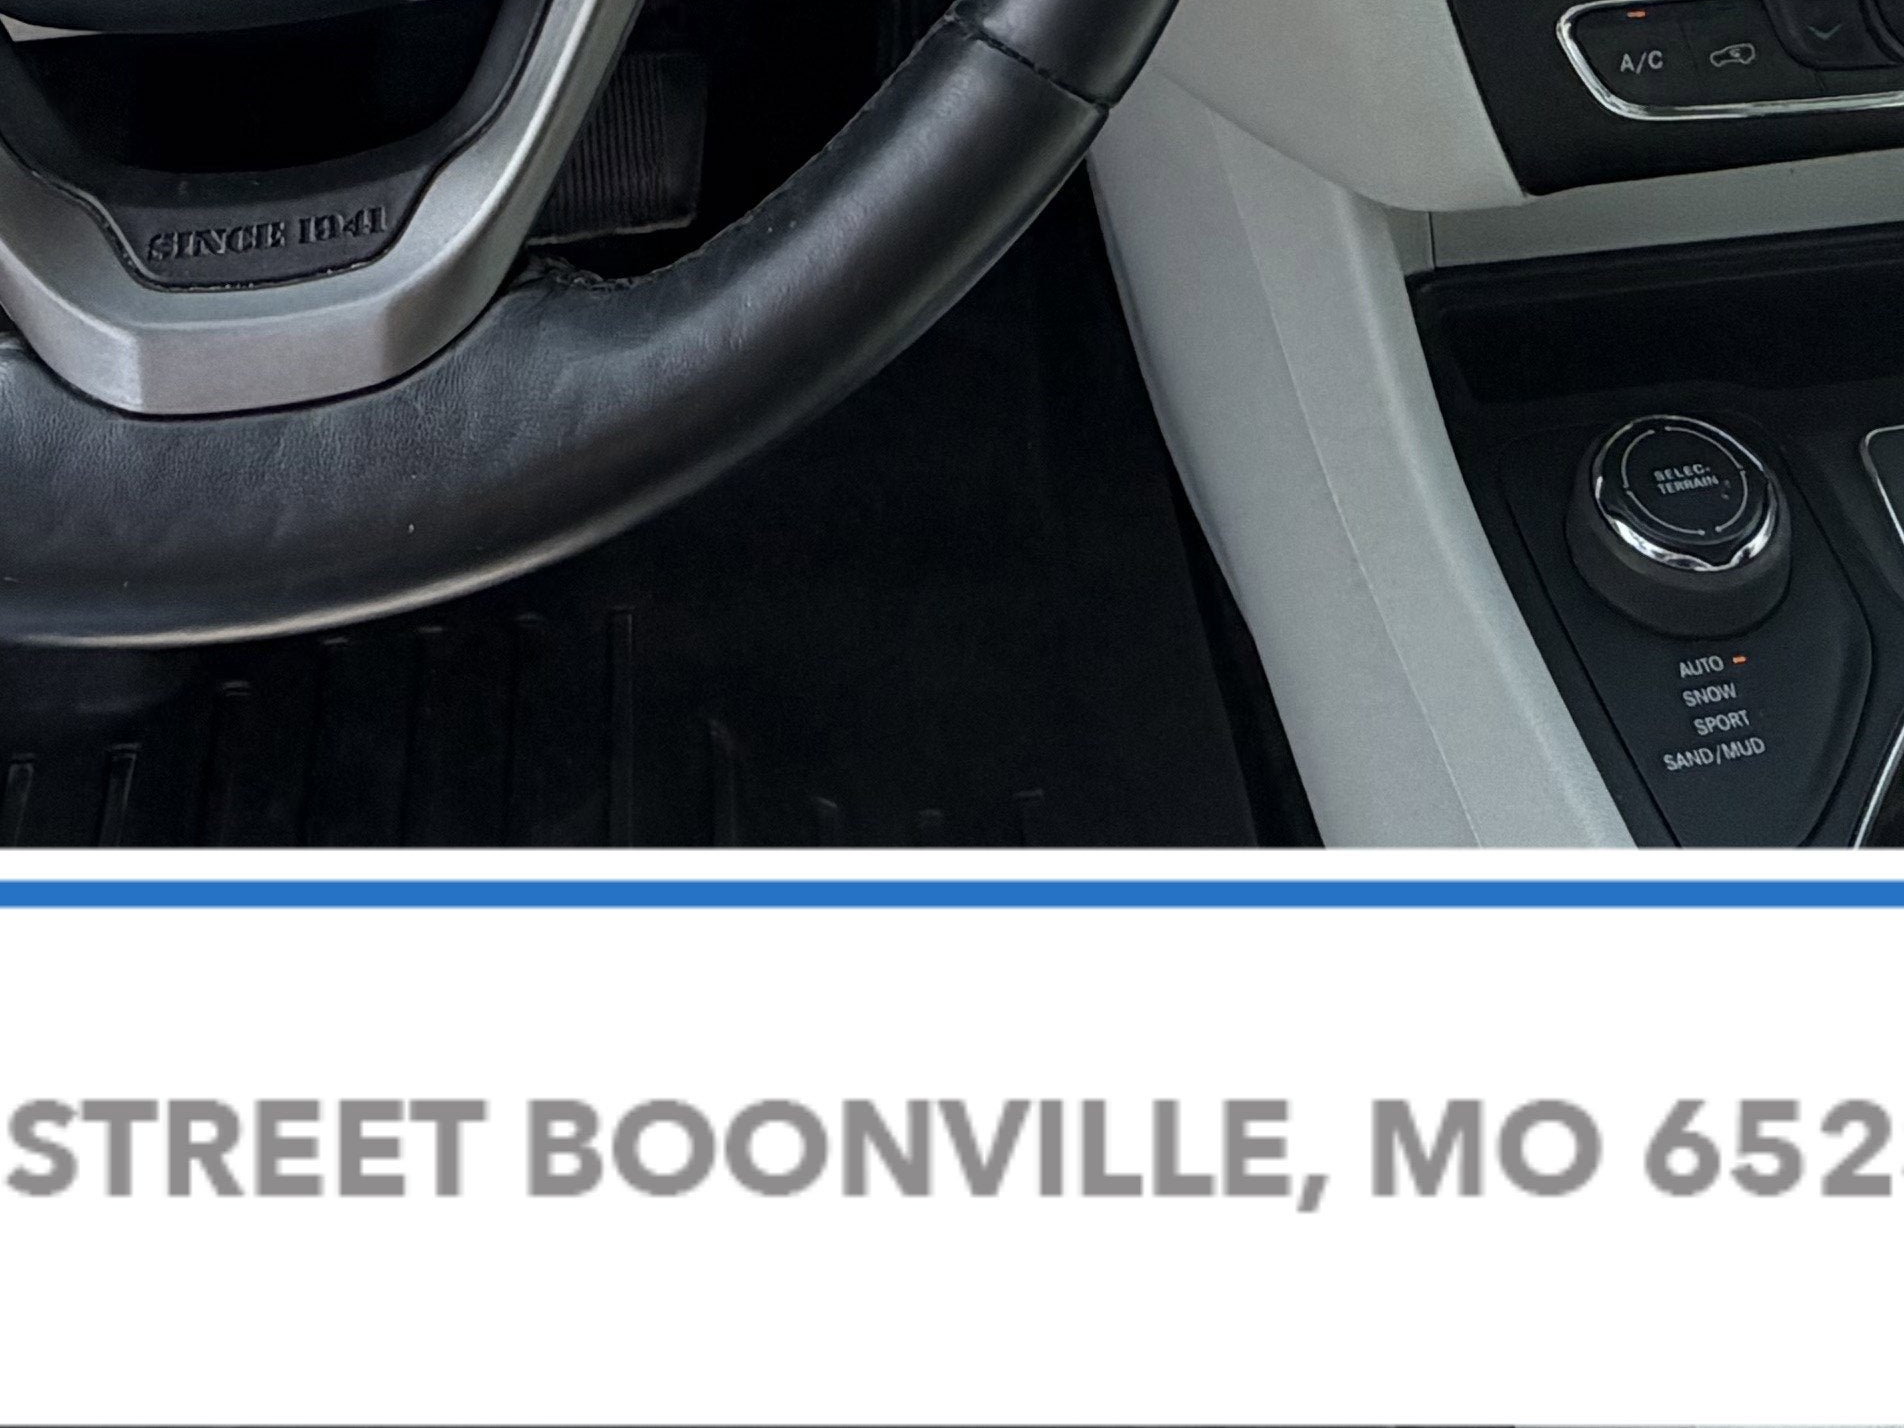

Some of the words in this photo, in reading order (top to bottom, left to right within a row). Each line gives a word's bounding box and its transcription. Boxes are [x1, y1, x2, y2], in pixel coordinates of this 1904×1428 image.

[1619, 48, 1664, 75] A/C
[147, 220, 286, 262] SINCE
[298, 206, 388, 245] 1941
[1657, 474, 1720, 495] TERRAIN
[1678, 655, 1725, 679] AUTO
[1682, 682, 1737, 708] SNOW
[1693, 709, 1751, 737] SPORT
[1662, 736, 1767, 773] SAND/MUD
